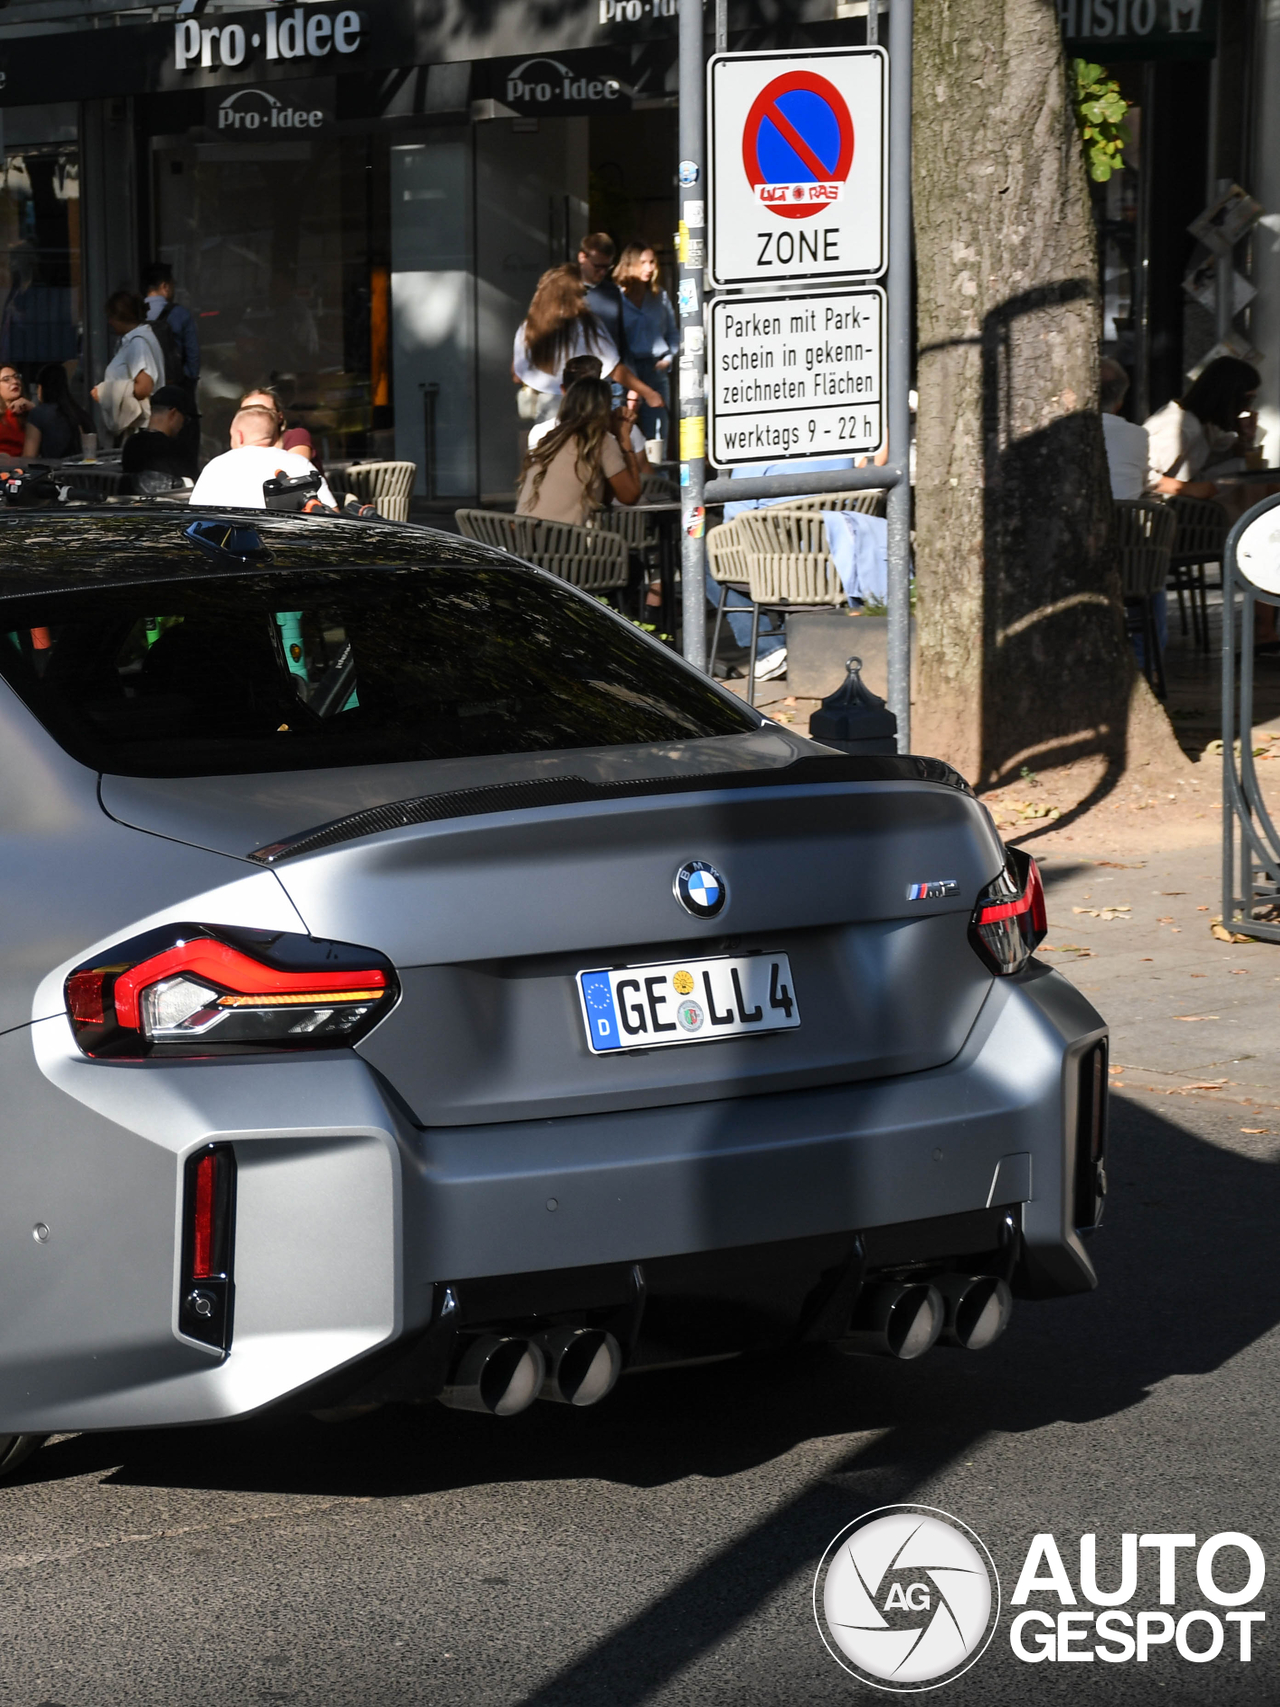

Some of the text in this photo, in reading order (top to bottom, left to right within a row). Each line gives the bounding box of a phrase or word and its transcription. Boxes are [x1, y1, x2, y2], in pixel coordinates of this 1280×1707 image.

[757, 228, 840, 266] ZONE
[725, 305, 871, 338] Parken mit Park-
[722, 340, 873, 372] schein in gekenn-
[723, 371, 873, 404] zeichneten Flächen
[724, 424, 800, 451] werktags
[808, 419, 816, 442] 9
[838, 415, 857, 440] 22
[863, 414, 872, 438] h
[616, 963, 794, 1036] GE LL 4
[597, 1019, 611, 1036] D
